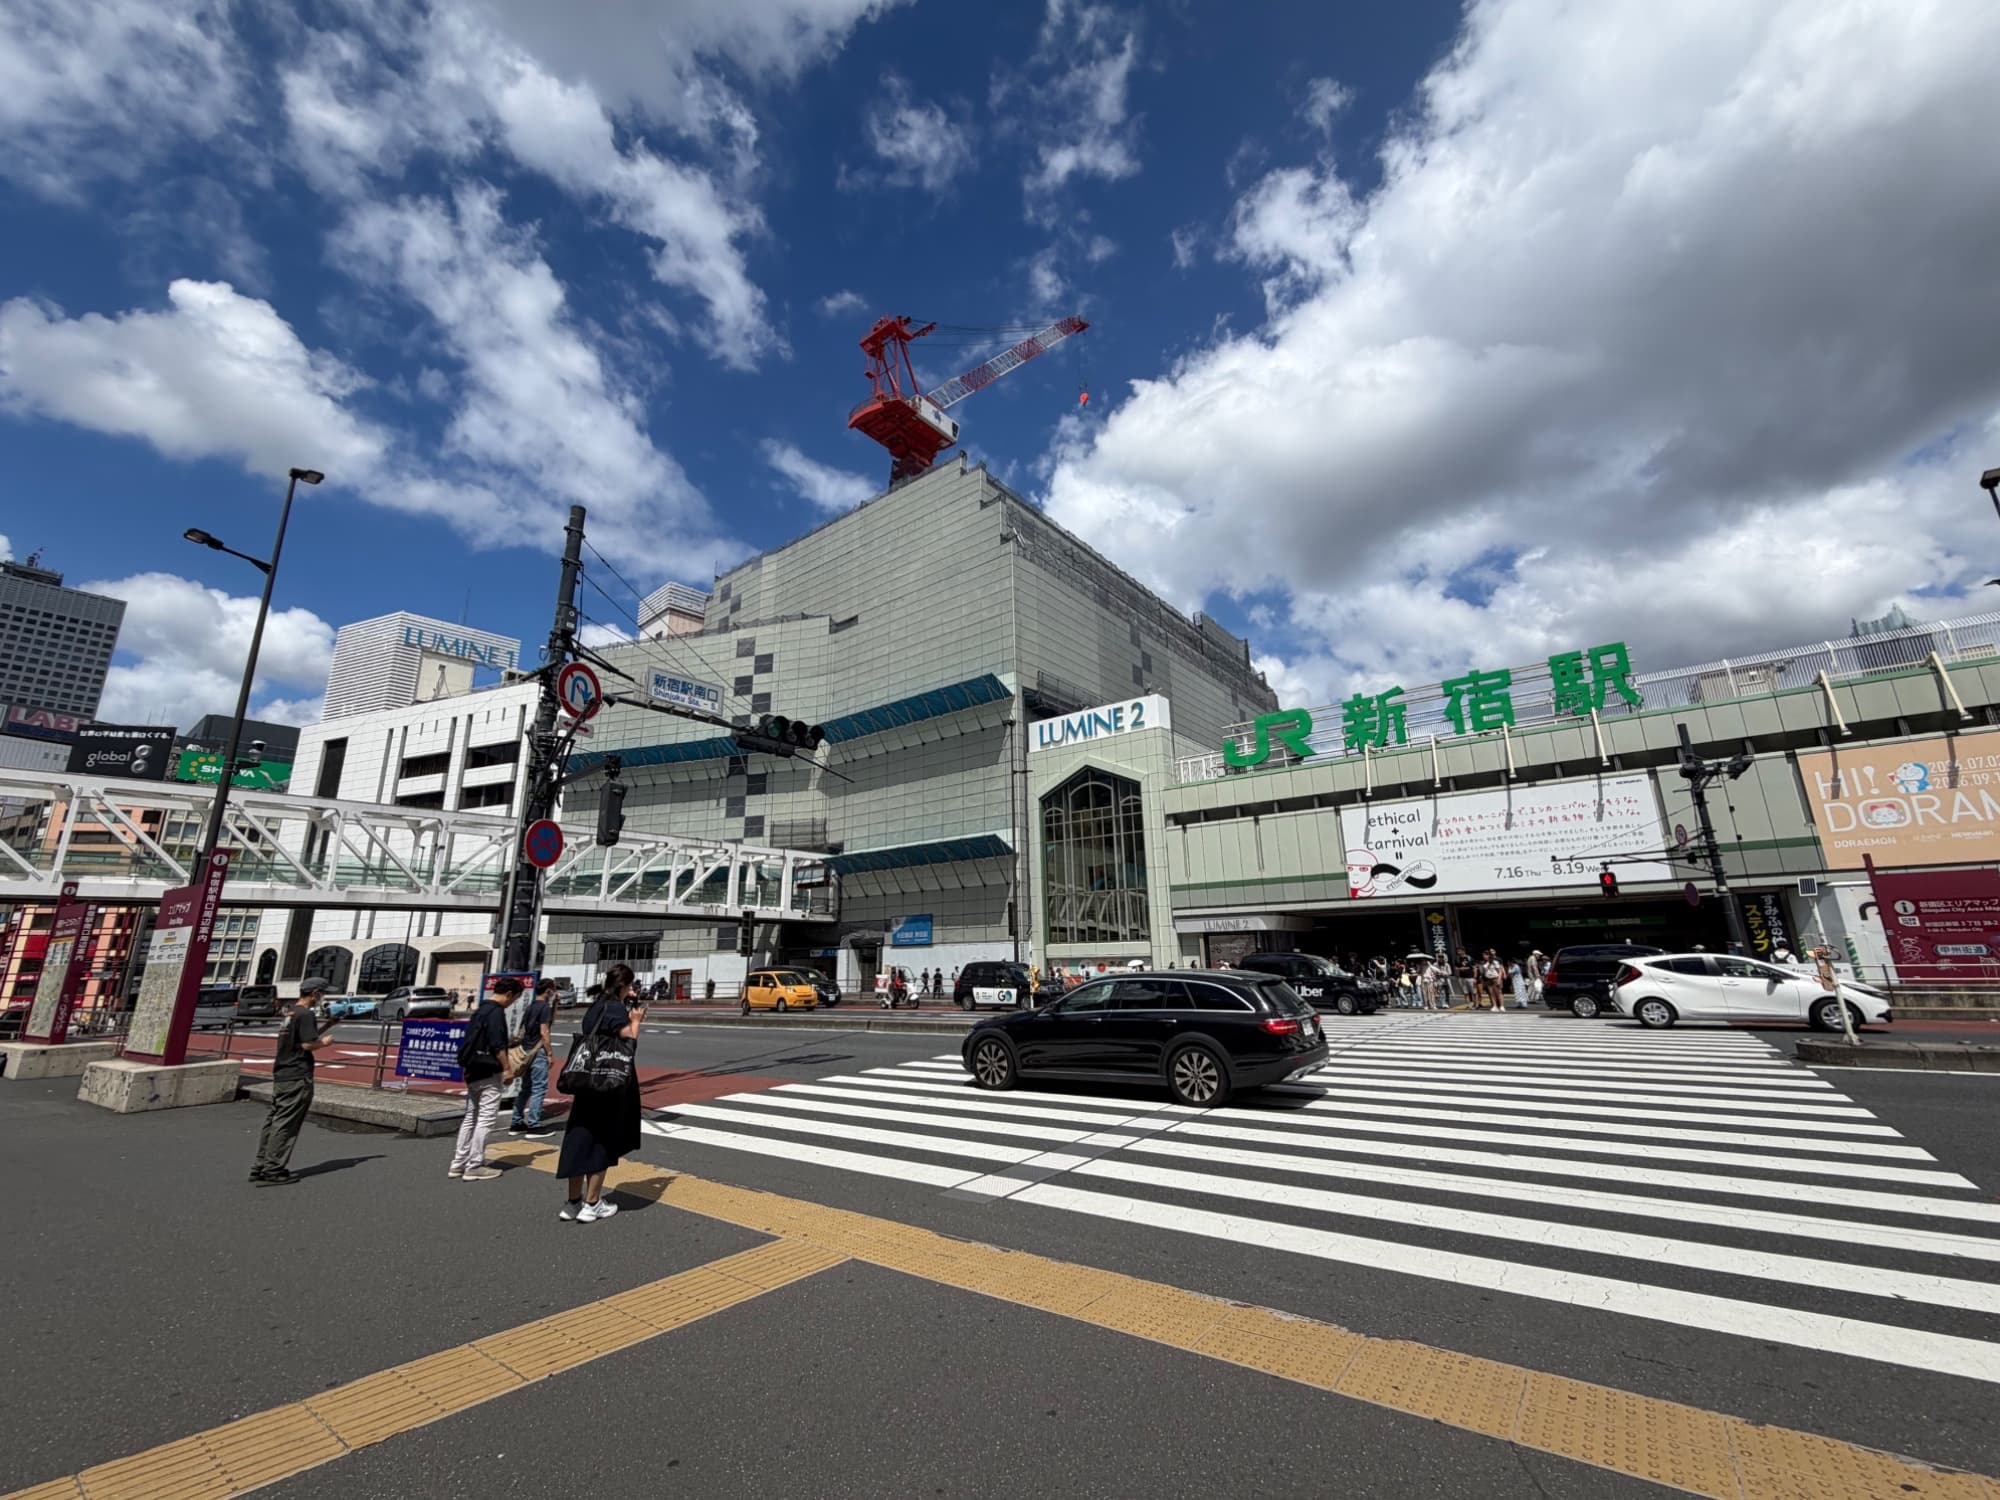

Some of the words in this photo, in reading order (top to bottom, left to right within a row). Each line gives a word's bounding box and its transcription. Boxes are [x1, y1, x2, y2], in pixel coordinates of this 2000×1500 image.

[403, 626, 507, 663] LUMINE
[509, 650, 515, 667] 1
[654, 673, 717, 702] 新宿駅南口
[654, 687, 686, 705] Shinjuku
[8, 705, 90, 732] LAB
[1038, 706, 1124, 747] LUMINE
[1129, 702, 1145, 728] 2
[86, 751, 131, 768] global
[200, 764, 256, 778] SHWA
[1814, 765, 1880, 799] HI!
[1368, 809, 1421, 828] ethical
[1366, 832, 1429, 851] carnival
[1834, 836, 1897, 849] DORAEMON
[1494, 866, 1524, 880] 7.16
[1525, 867, 1541, 877] Thu
[1553, 862, 1585, 876] 8.19
[1585, 864, 1608, 874] We
[1203, 919, 1241, 931] LUMINE
[1242, 920, 1249, 929] 2
[1744, 905, 1769, 952] ステップ
[1940, 946, 1984, 954] 甲州街道
[997, 990, 1012, 1002] GO
[1295, 985, 1324, 998] Uber
